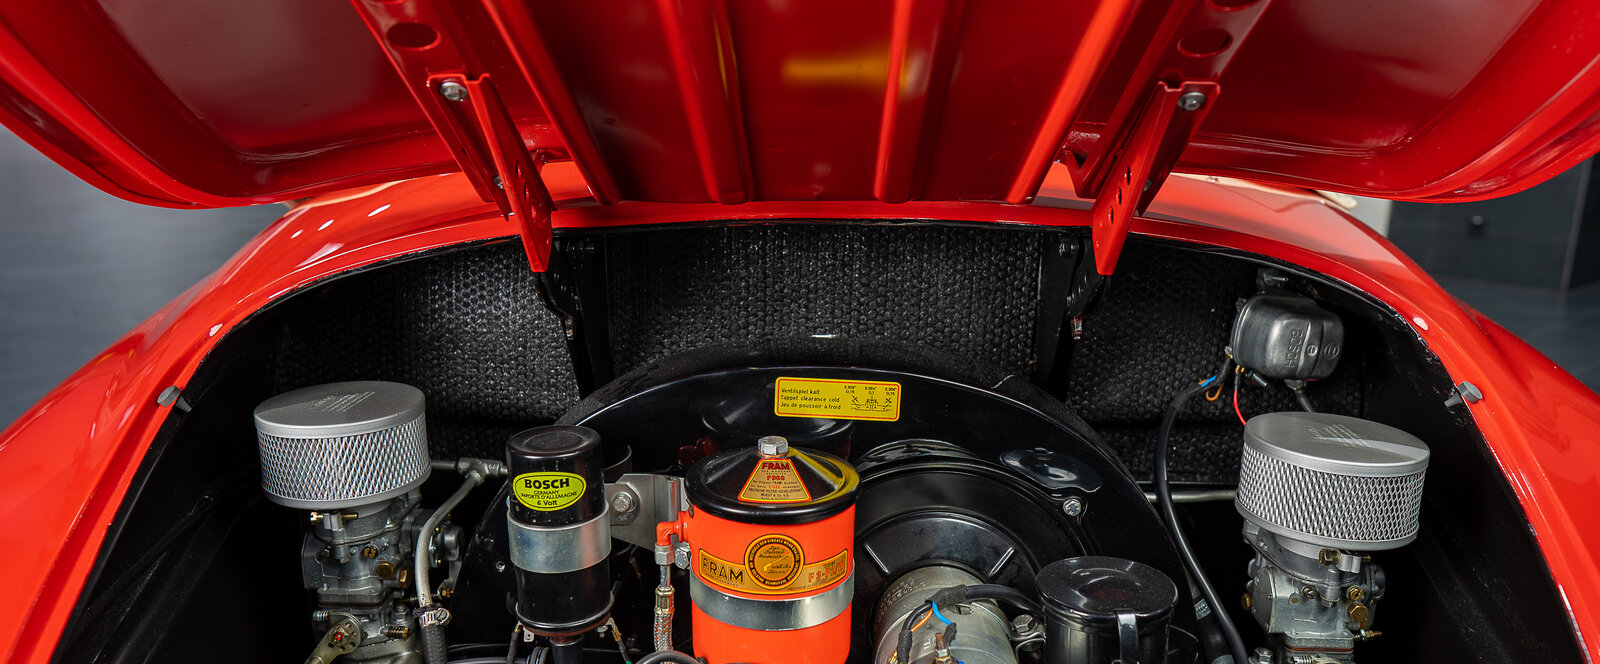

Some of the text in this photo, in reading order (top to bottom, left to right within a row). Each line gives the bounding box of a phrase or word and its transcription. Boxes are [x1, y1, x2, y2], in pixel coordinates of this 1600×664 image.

[1285, 330, 1304, 368] BOSCH
[525, 478, 569, 489] BOSCH
[702, 556, 744, 584] FRAM
